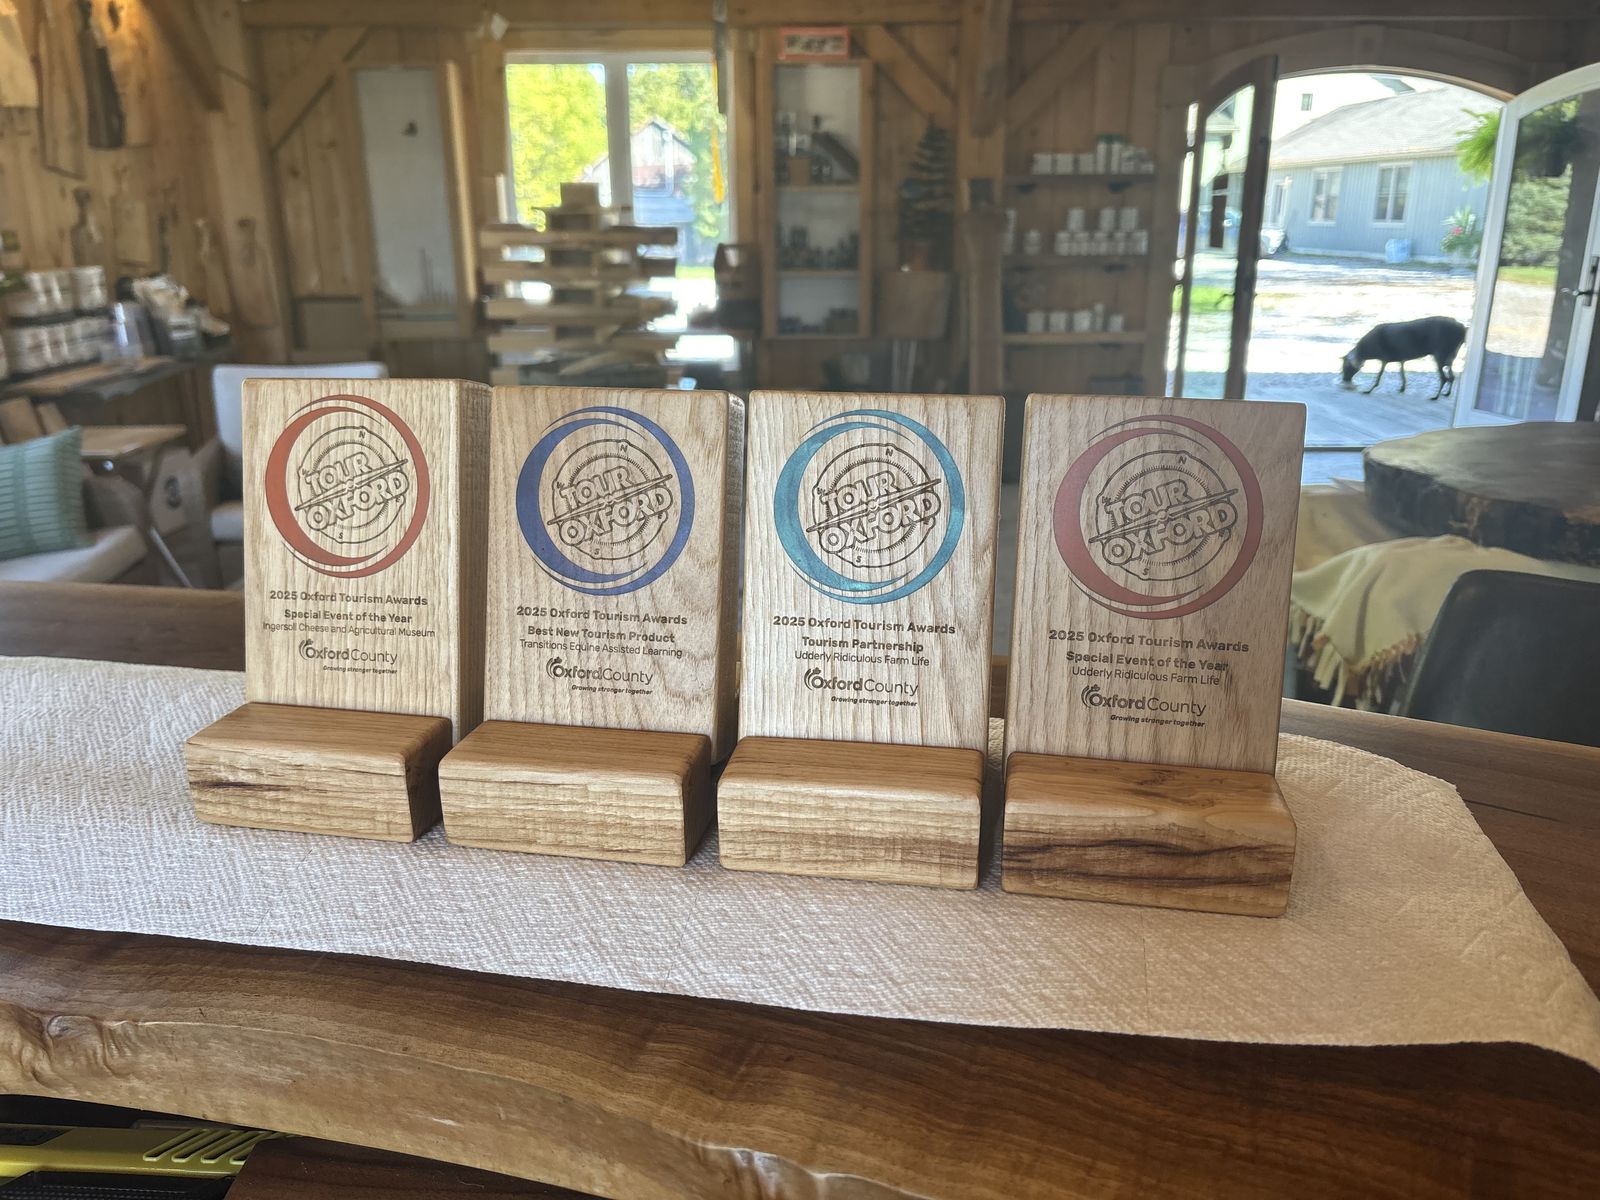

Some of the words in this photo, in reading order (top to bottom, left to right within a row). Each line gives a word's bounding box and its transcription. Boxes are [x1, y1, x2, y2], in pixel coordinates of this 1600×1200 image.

[306, 452, 372, 496] TOUR
[560, 466, 632, 510] TOUR
[820, 470, 900, 516] TOUR
[306, 471, 409, 531] OXFORD
[1105, 479, 1192, 528] TOUR
[560, 486, 673, 546] OXFORD
[820, 491, 941, 554] OXFORD
[1102, 501, 1238, 565] OXFORD
[270, 591, 297, 600] 2025
[300, 592, 336, 601] Oxford
[340, 593, 383, 603] Tourism
[385, 595, 428, 605] Awards
[284, 609, 321, 620] Special
[324, 611, 353, 620] Event
[356, 612, 367, 621] of
[369, 613, 386, 621] the
[388, 614, 412, 623] Year
[517, 606, 546, 617] 2025
[550, 608, 590, 619] Oxford
[593, 610, 640, 621] Tourism
[642, 613, 688, 624] Awards
[299, 623, 329, 632] Cheese
[331, 625, 346, 633] and
[348, 626, 396, 636] Agricultural
[399, 628, 435, 637] Museum
[528, 626, 553, 635] Best
[556, 628, 579, 637] New
[582, 629, 626, 640] Tourism
[629, 632, 675, 642] Product
[773, 616, 805, 626] 2025
[809, 618, 850, 628] Oxford
[854, 619, 904, 631] Tourism
[907, 622, 955, 634] Awards
[520, 639, 567, 650] Transitions
[570, 642, 600, 652] Equine
[602, 644, 640, 654] Assisted
[643, 647, 682, 659] Learning
[802, 636, 848, 648] Tourism
[852, 639, 924, 653] Partnership
[1049, 630, 1084, 641] 2025
[1088, 632, 1134, 644] Oxford
[1138, 635, 1193, 648] Tourism
[1196, 639, 1249, 652] Awards
[795, 651, 831, 662] Udderly
[834, 653, 882, 663] Ridiculous
[885, 655, 909, 664] Farm
[912, 657, 929, 666] Life
[1066, 651, 1113, 664] Special
[1116, 654, 1154, 666] Event
[1157, 657, 1171, 667] of
[1174, 658, 1196, 668] the
[1198, 660, 1228, 671] Year
[1072, 667, 1112, 679] Udderly
[1114, 670, 1168, 682] Ridiculous
[1171, 673, 1197, 683] Farm
[1201, 675, 1220, 685] Life
[831, 696, 857, 704] Growing
[1111, 715, 1139, 723] Growing
